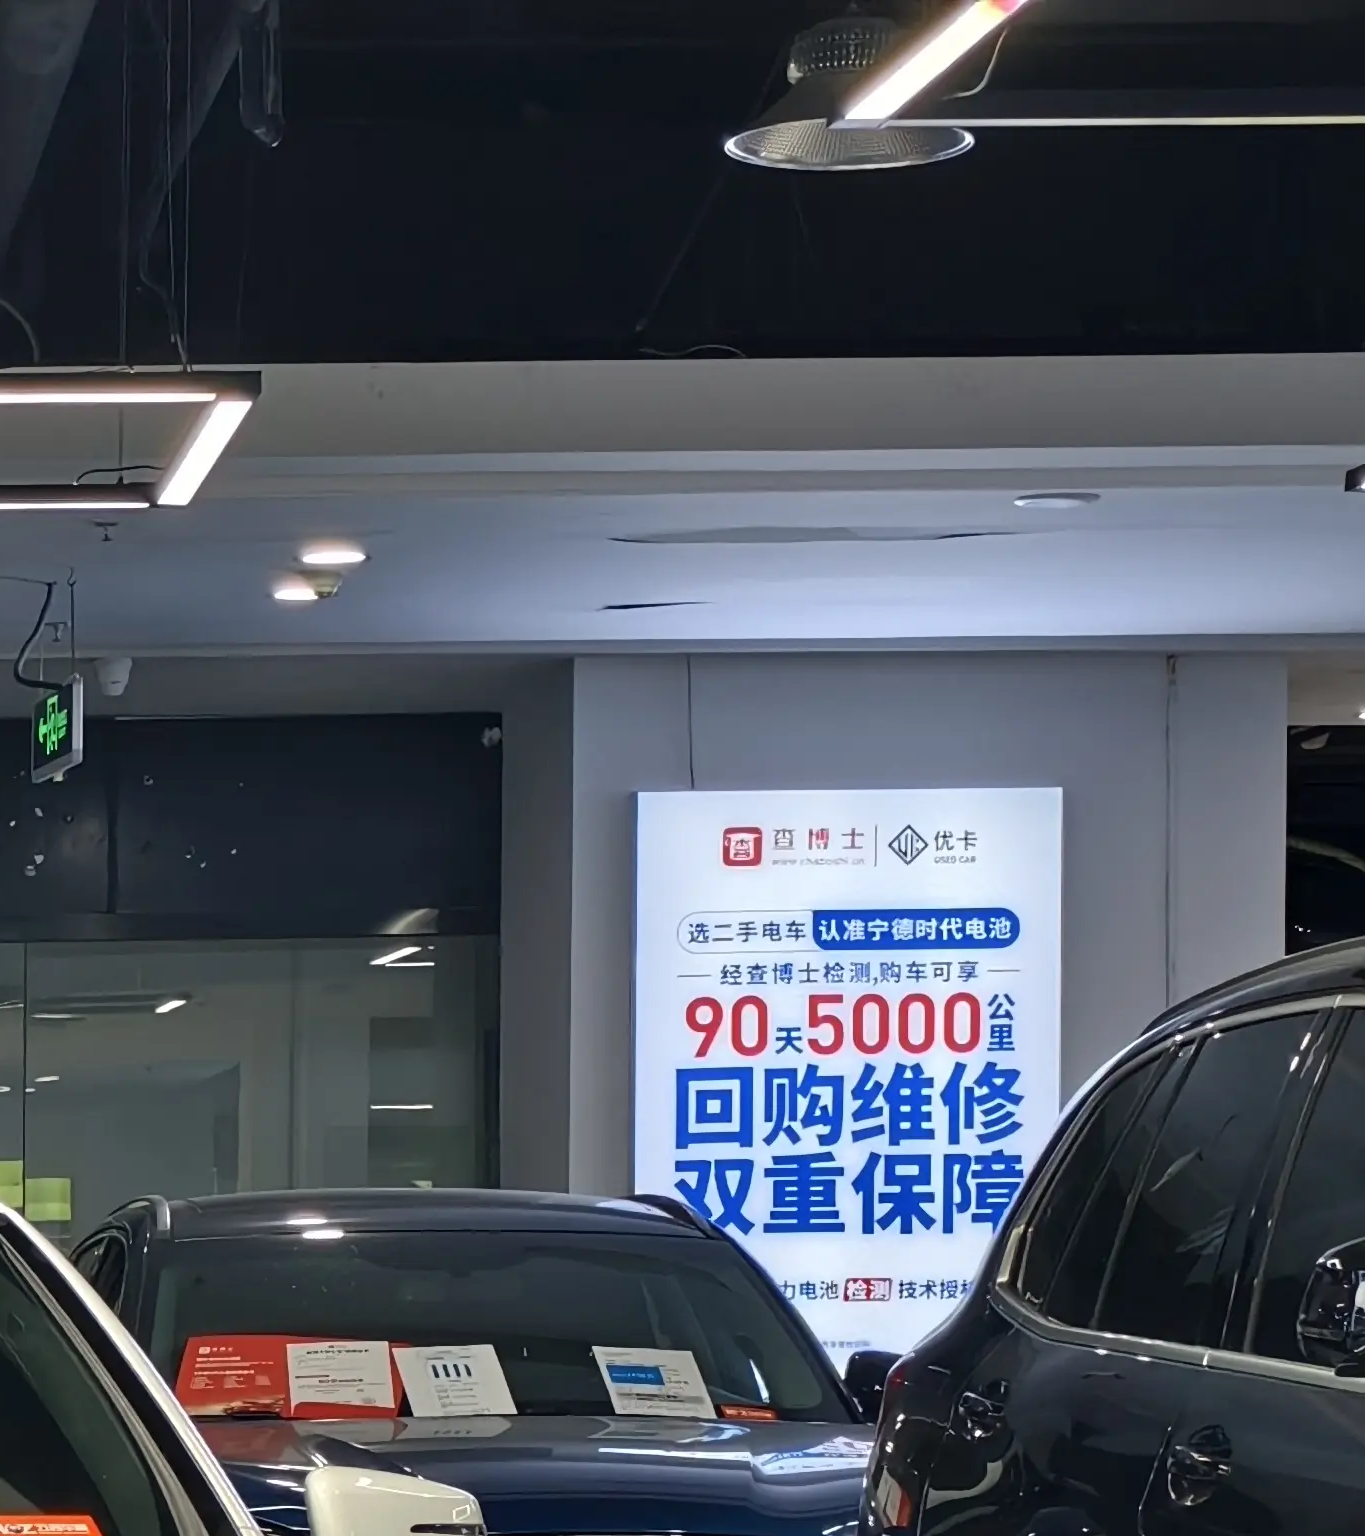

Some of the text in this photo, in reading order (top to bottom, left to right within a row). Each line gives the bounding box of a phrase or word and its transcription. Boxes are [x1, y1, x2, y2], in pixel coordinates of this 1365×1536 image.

[934, 829, 978, 852] 优卡
[687, 917, 1013, 945] 选二手电车 认准宁德时代电池
[674, 1060, 1026, 1149] 回购维修
[673, 1148, 1026, 1236] 双重保障
[846, 1279, 891, 1301] 检测
